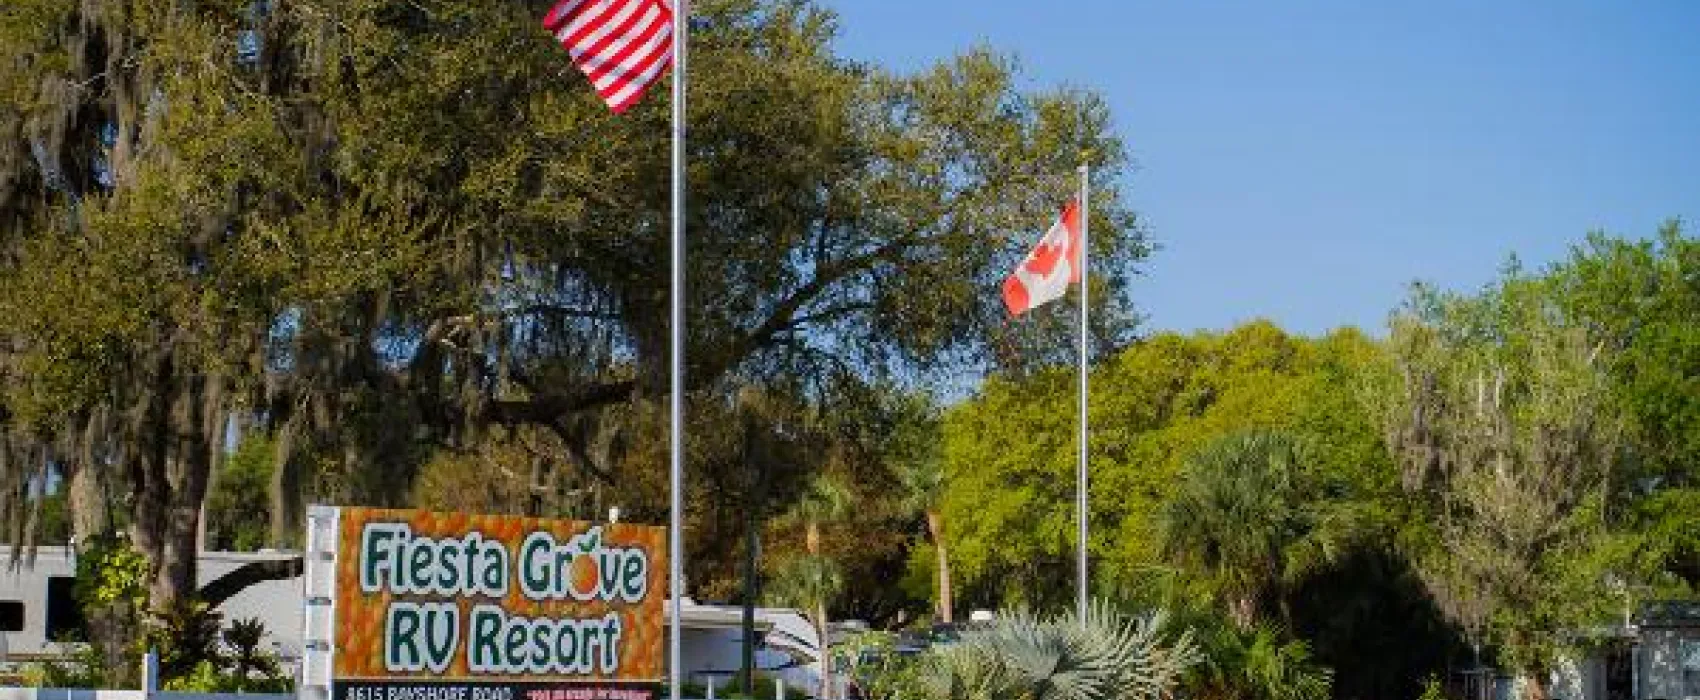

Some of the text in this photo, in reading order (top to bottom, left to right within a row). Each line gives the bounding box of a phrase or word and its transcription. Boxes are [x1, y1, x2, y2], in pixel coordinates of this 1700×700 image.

[364, 528, 645, 597] Fiesta Grove
[389, 607, 619, 670] RV Resort
